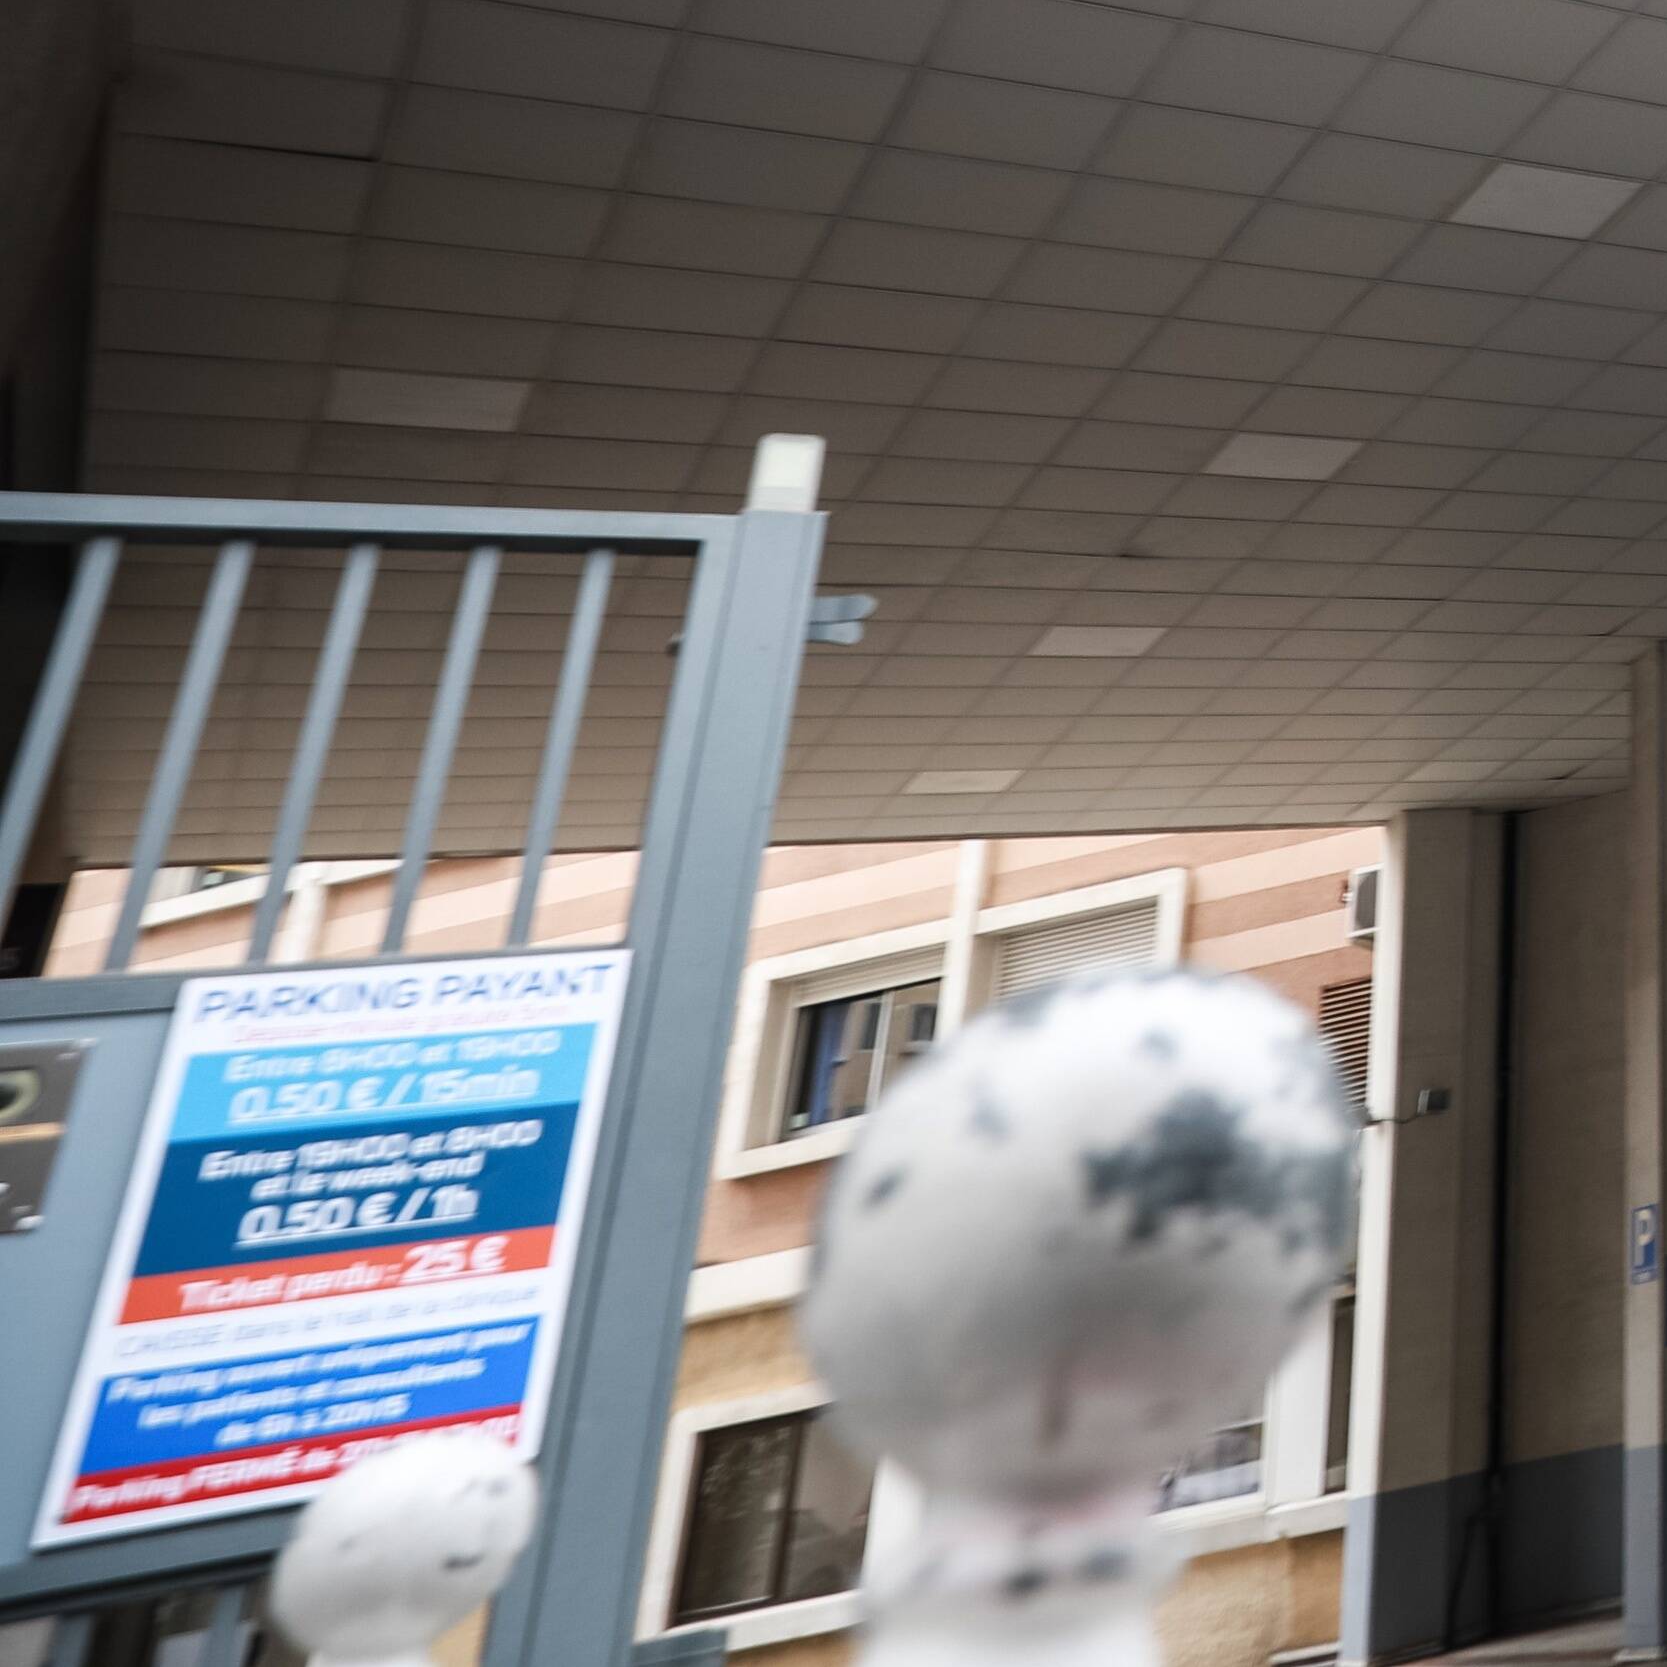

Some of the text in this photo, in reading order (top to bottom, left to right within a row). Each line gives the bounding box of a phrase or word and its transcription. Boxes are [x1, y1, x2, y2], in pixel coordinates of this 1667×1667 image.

[195, 963, 615, 1023] PARKING PAYANT
[178, 1276, 286, 1312] Ticket
[400, 1239, 471, 1281] 25
[470, 1235, 510, 1270] €
